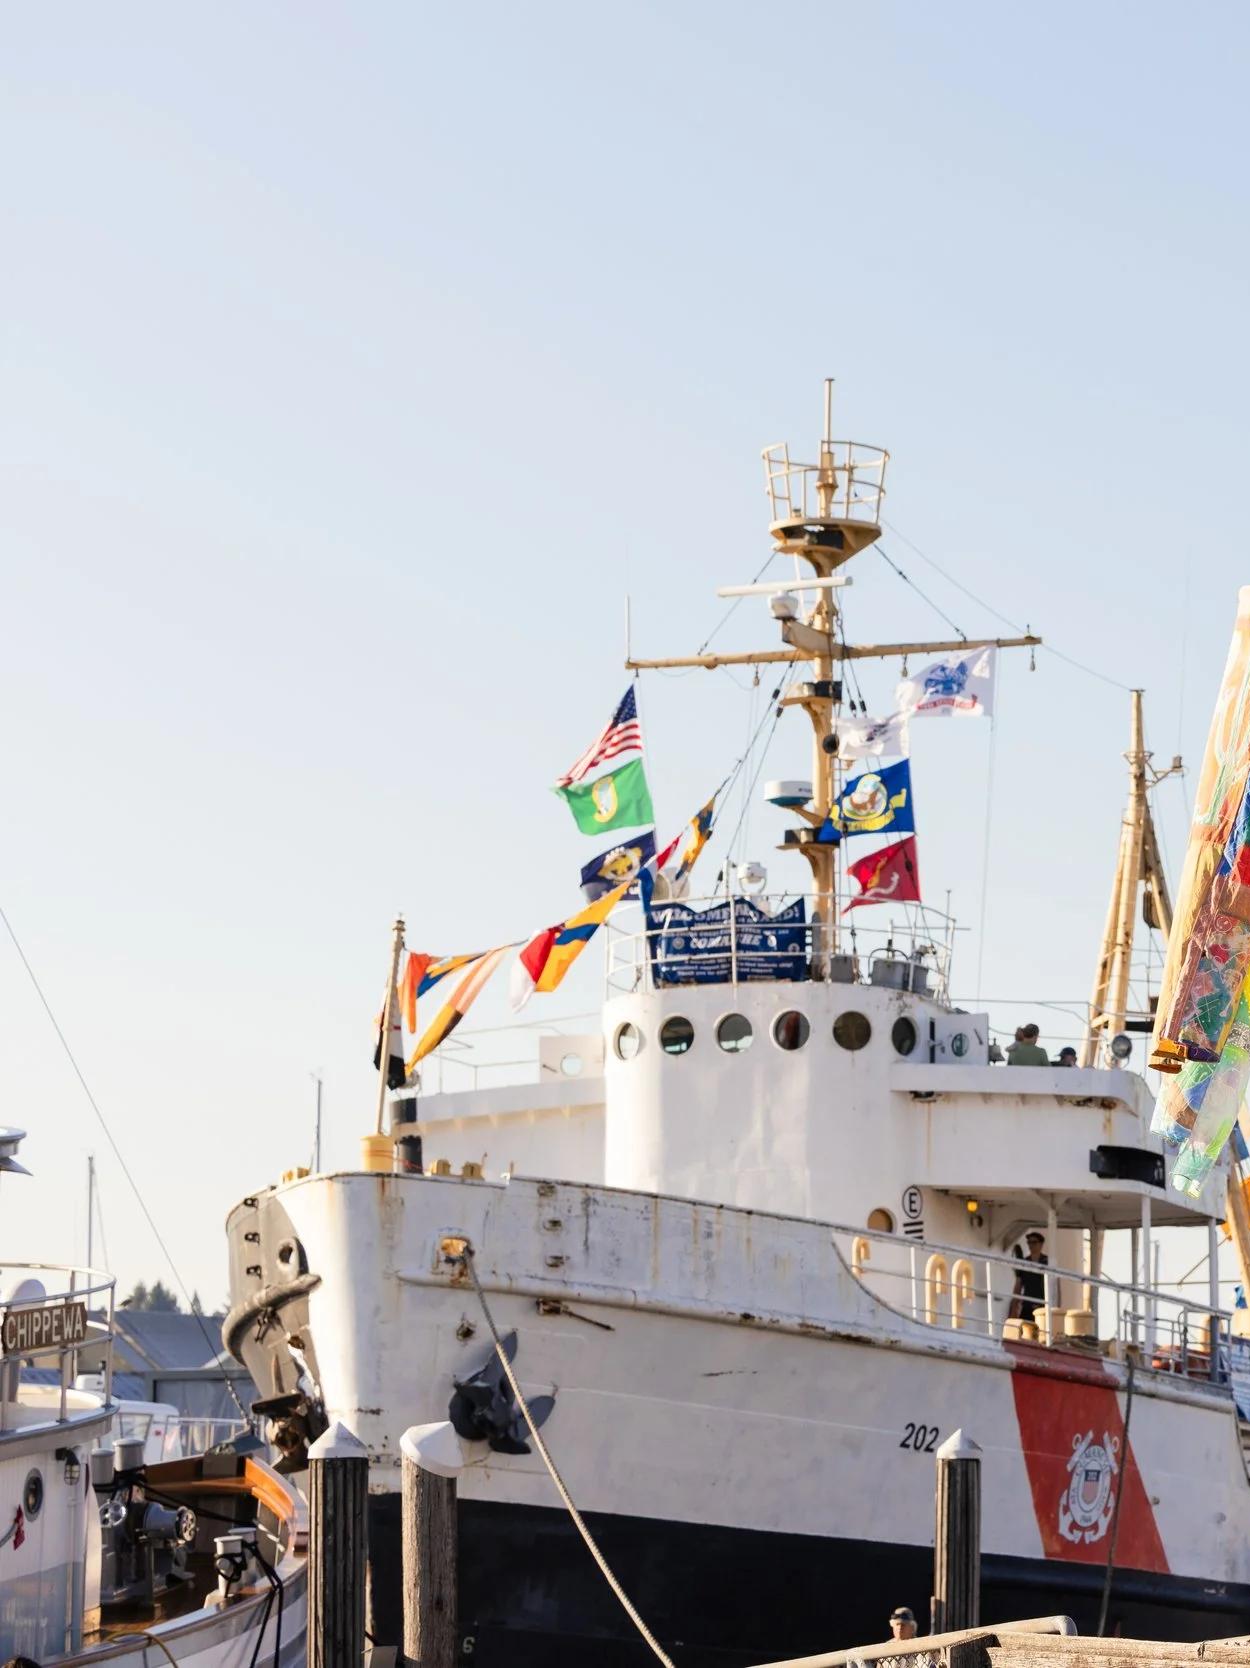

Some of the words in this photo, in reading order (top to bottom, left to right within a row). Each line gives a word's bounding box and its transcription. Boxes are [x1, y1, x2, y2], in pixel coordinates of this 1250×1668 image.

[909, 1192, 917, 1213] E
[6, 1305, 84, 1349] CHIPPEWA
[899, 1422, 939, 1453] 202
[462, 1636, 475, 1654] 6
